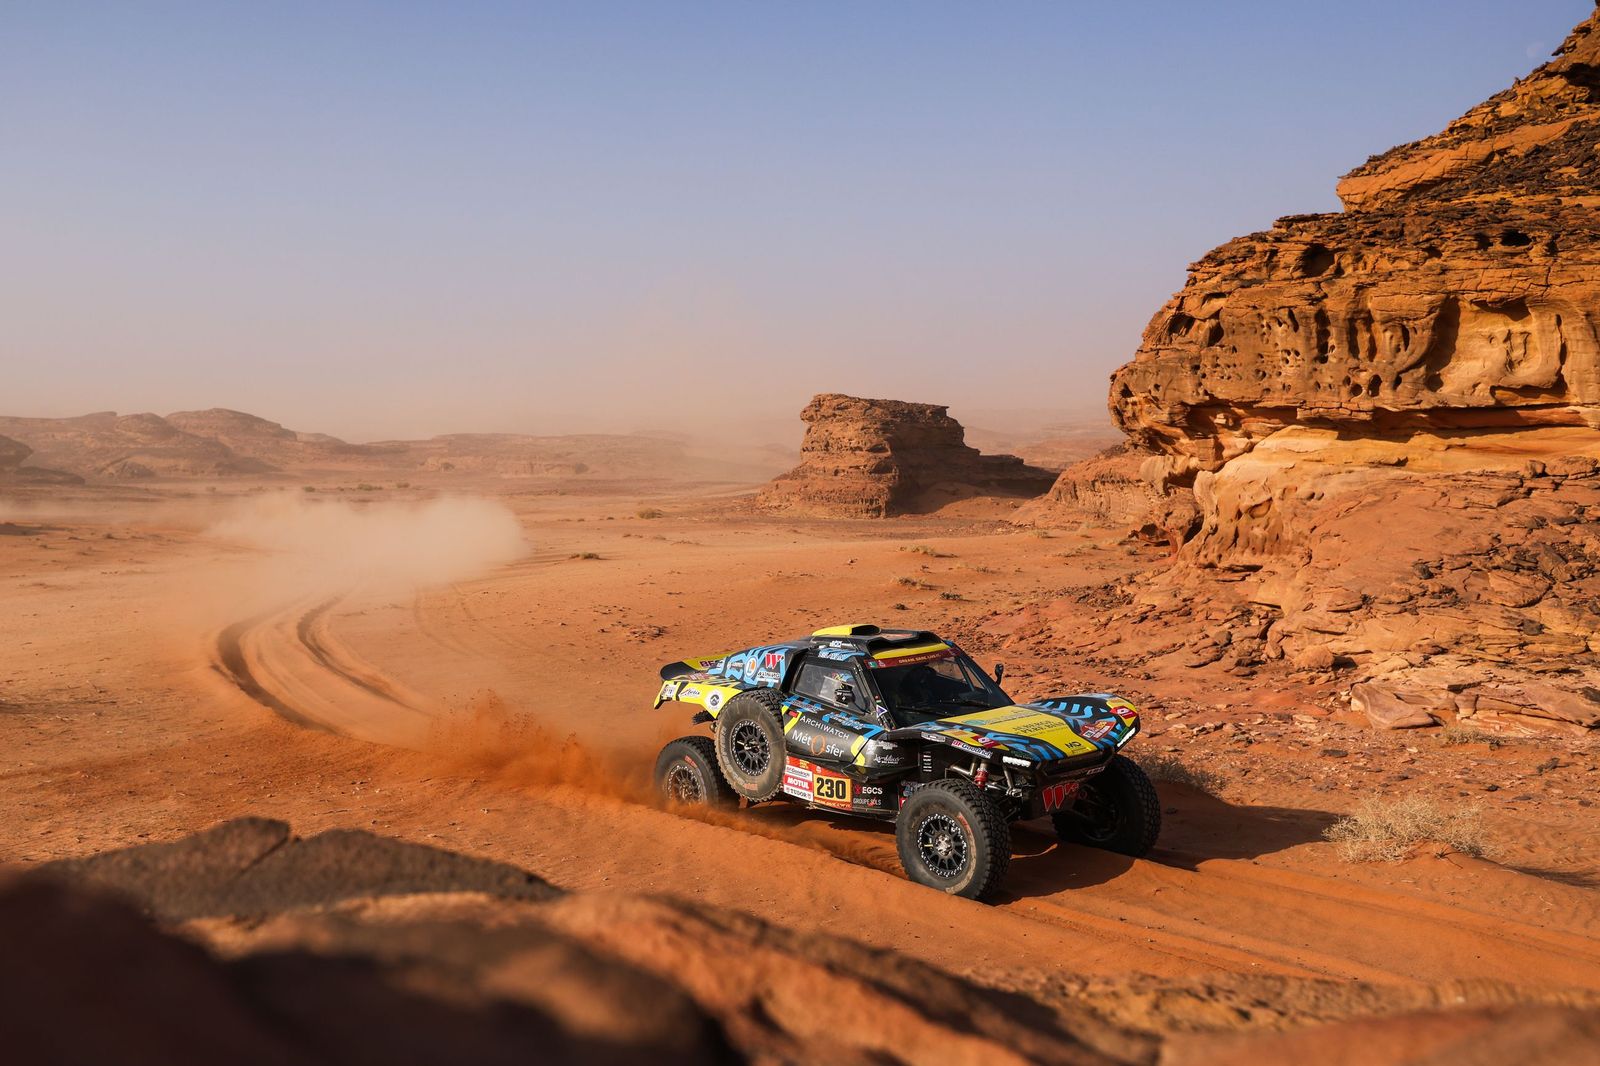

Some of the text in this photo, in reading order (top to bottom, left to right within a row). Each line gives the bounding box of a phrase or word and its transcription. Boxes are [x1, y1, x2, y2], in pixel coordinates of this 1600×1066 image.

[800, 715, 850, 740] ARCHIWATCH
[787, 776, 810, 790] MOTUL
[816, 776, 846, 800] 230
[862, 786, 883, 795] EGCS
